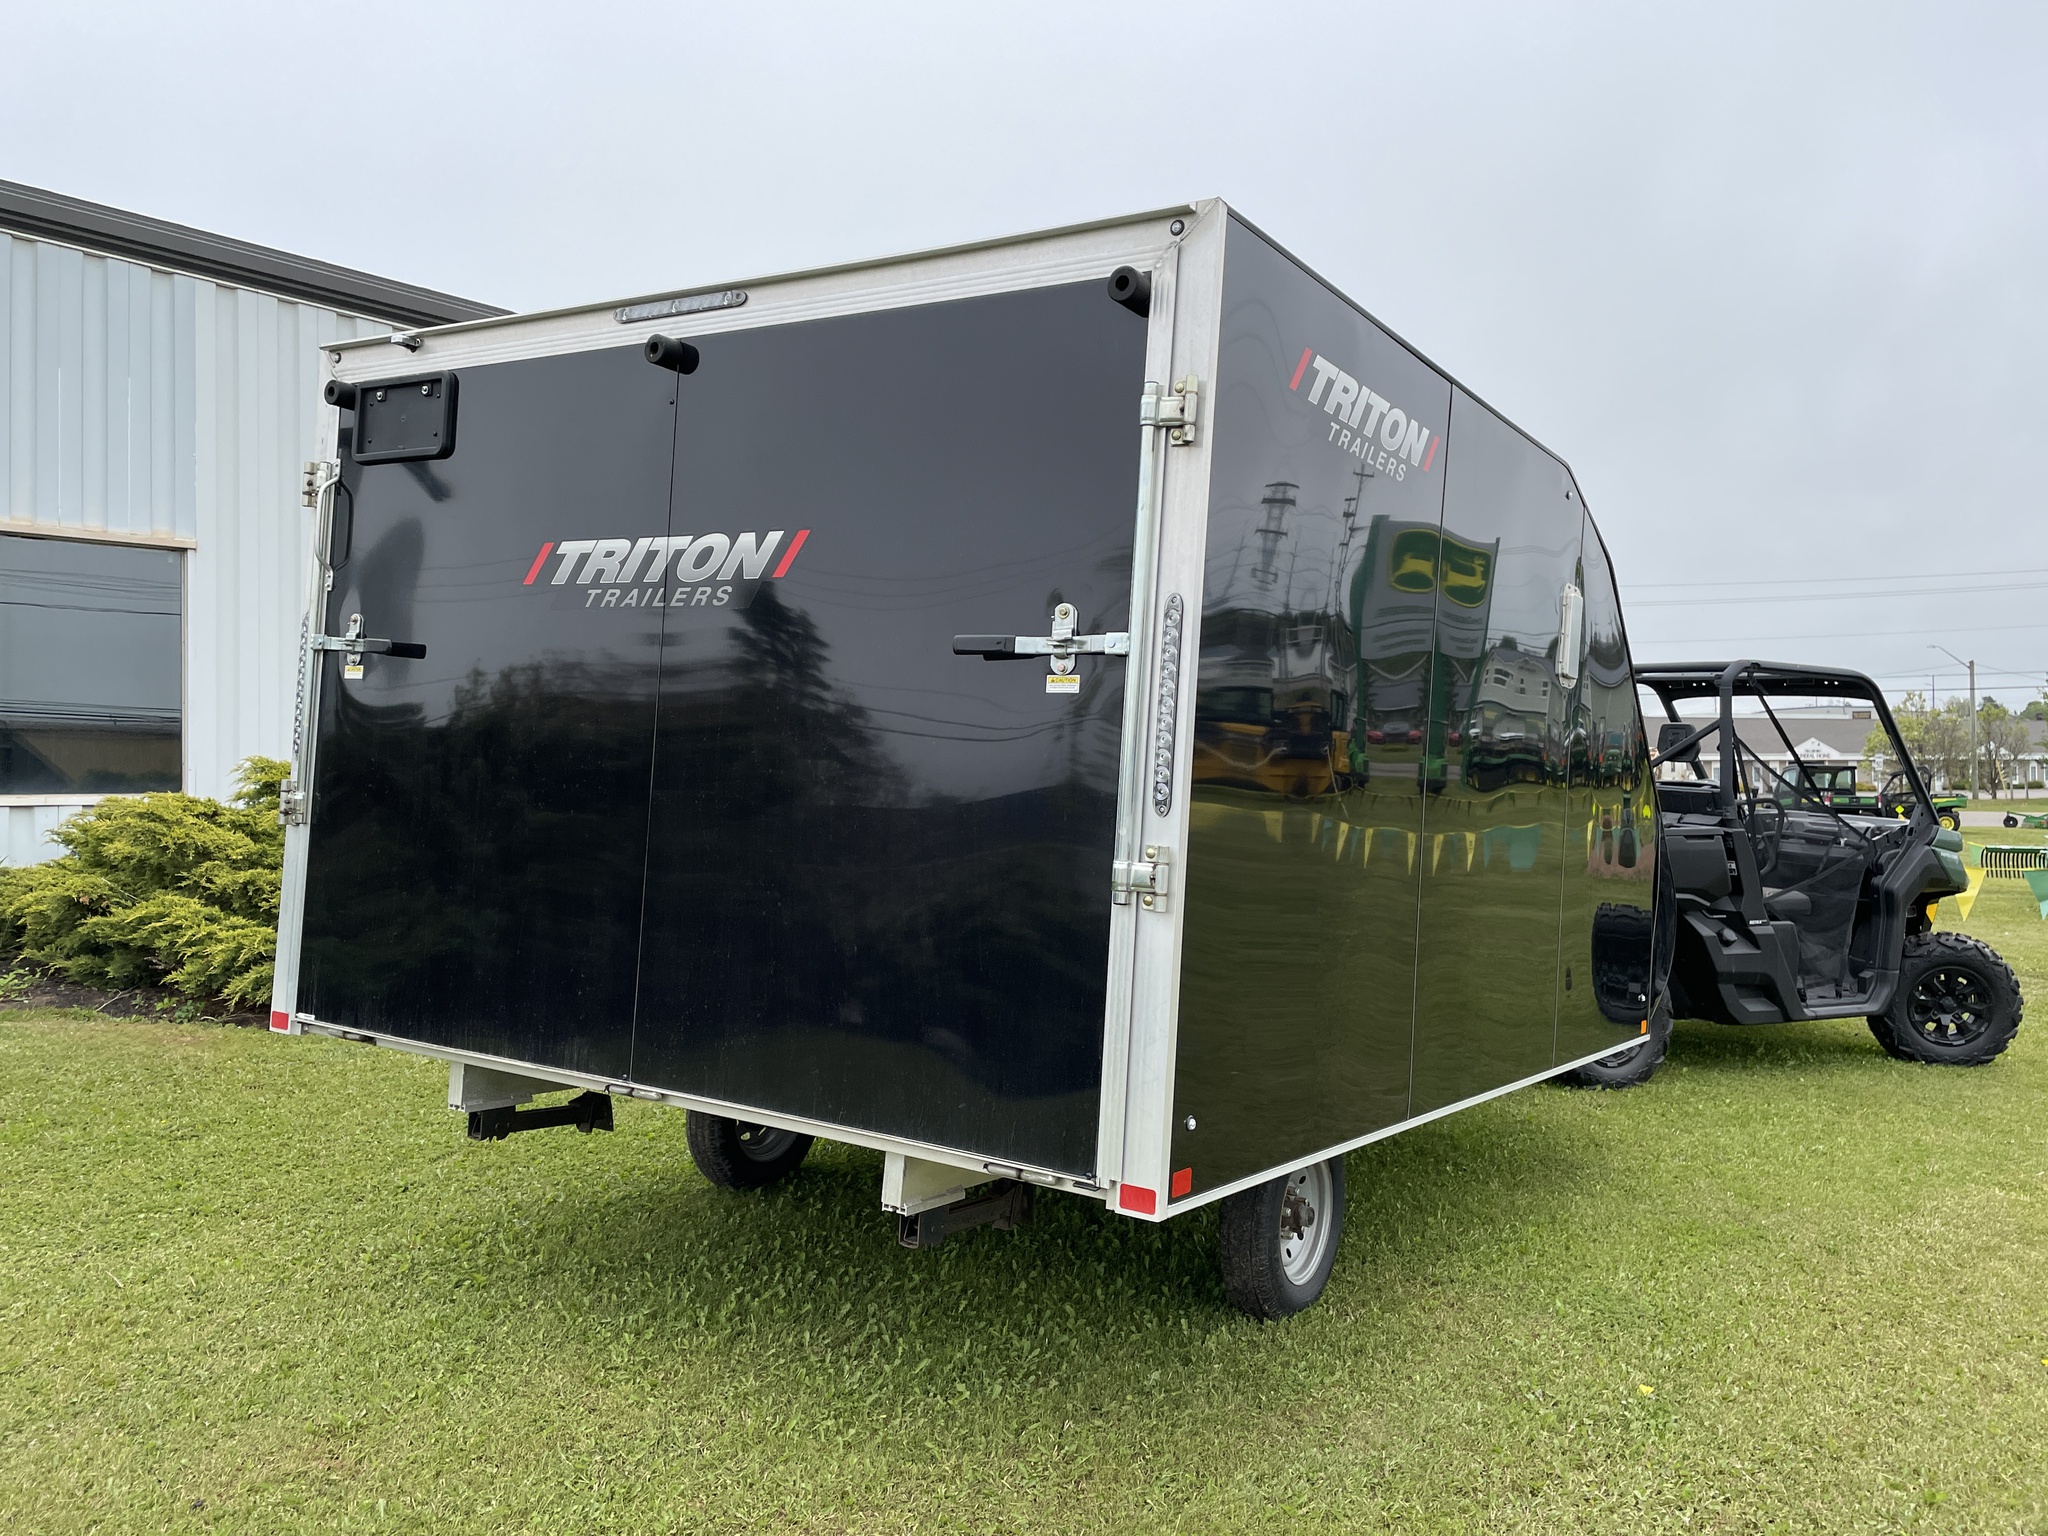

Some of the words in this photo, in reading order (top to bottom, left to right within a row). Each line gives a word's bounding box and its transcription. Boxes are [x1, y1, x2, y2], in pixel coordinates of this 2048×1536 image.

[1307, 354, 1430, 467] TRITON
[1328, 421, 1407, 482] TRAILERS
[551, 530, 785, 585] TRITON
[585, 586, 733, 608] TRAILERS
